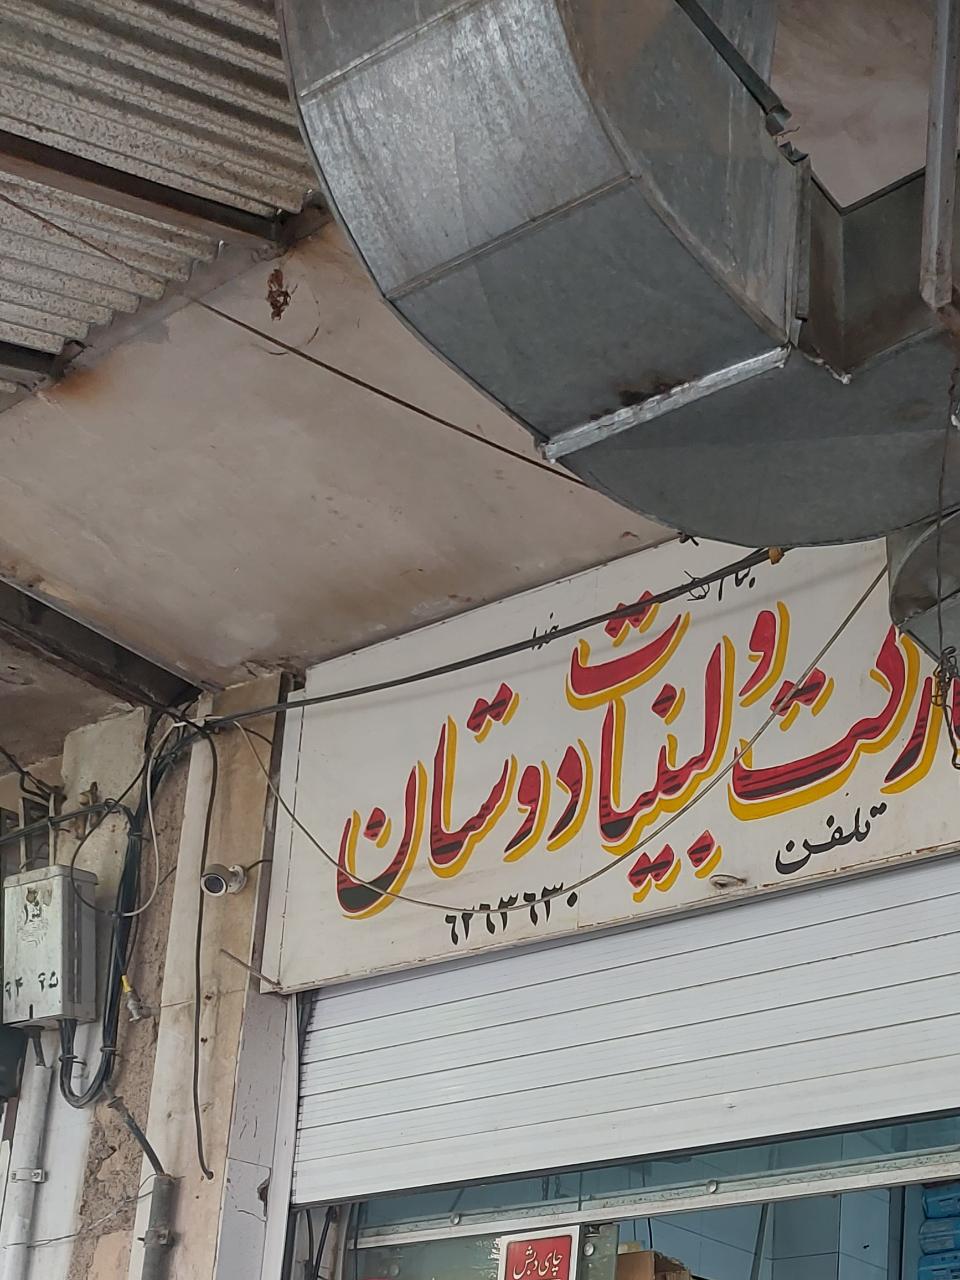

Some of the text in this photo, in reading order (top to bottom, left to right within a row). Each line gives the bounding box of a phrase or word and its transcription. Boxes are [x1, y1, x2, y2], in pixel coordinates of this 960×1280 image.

[336, 682, 593, 921] دوستان
[775, 802, 887, 874] تلفن
[513, 1246, 563, 1280] چای دبش
